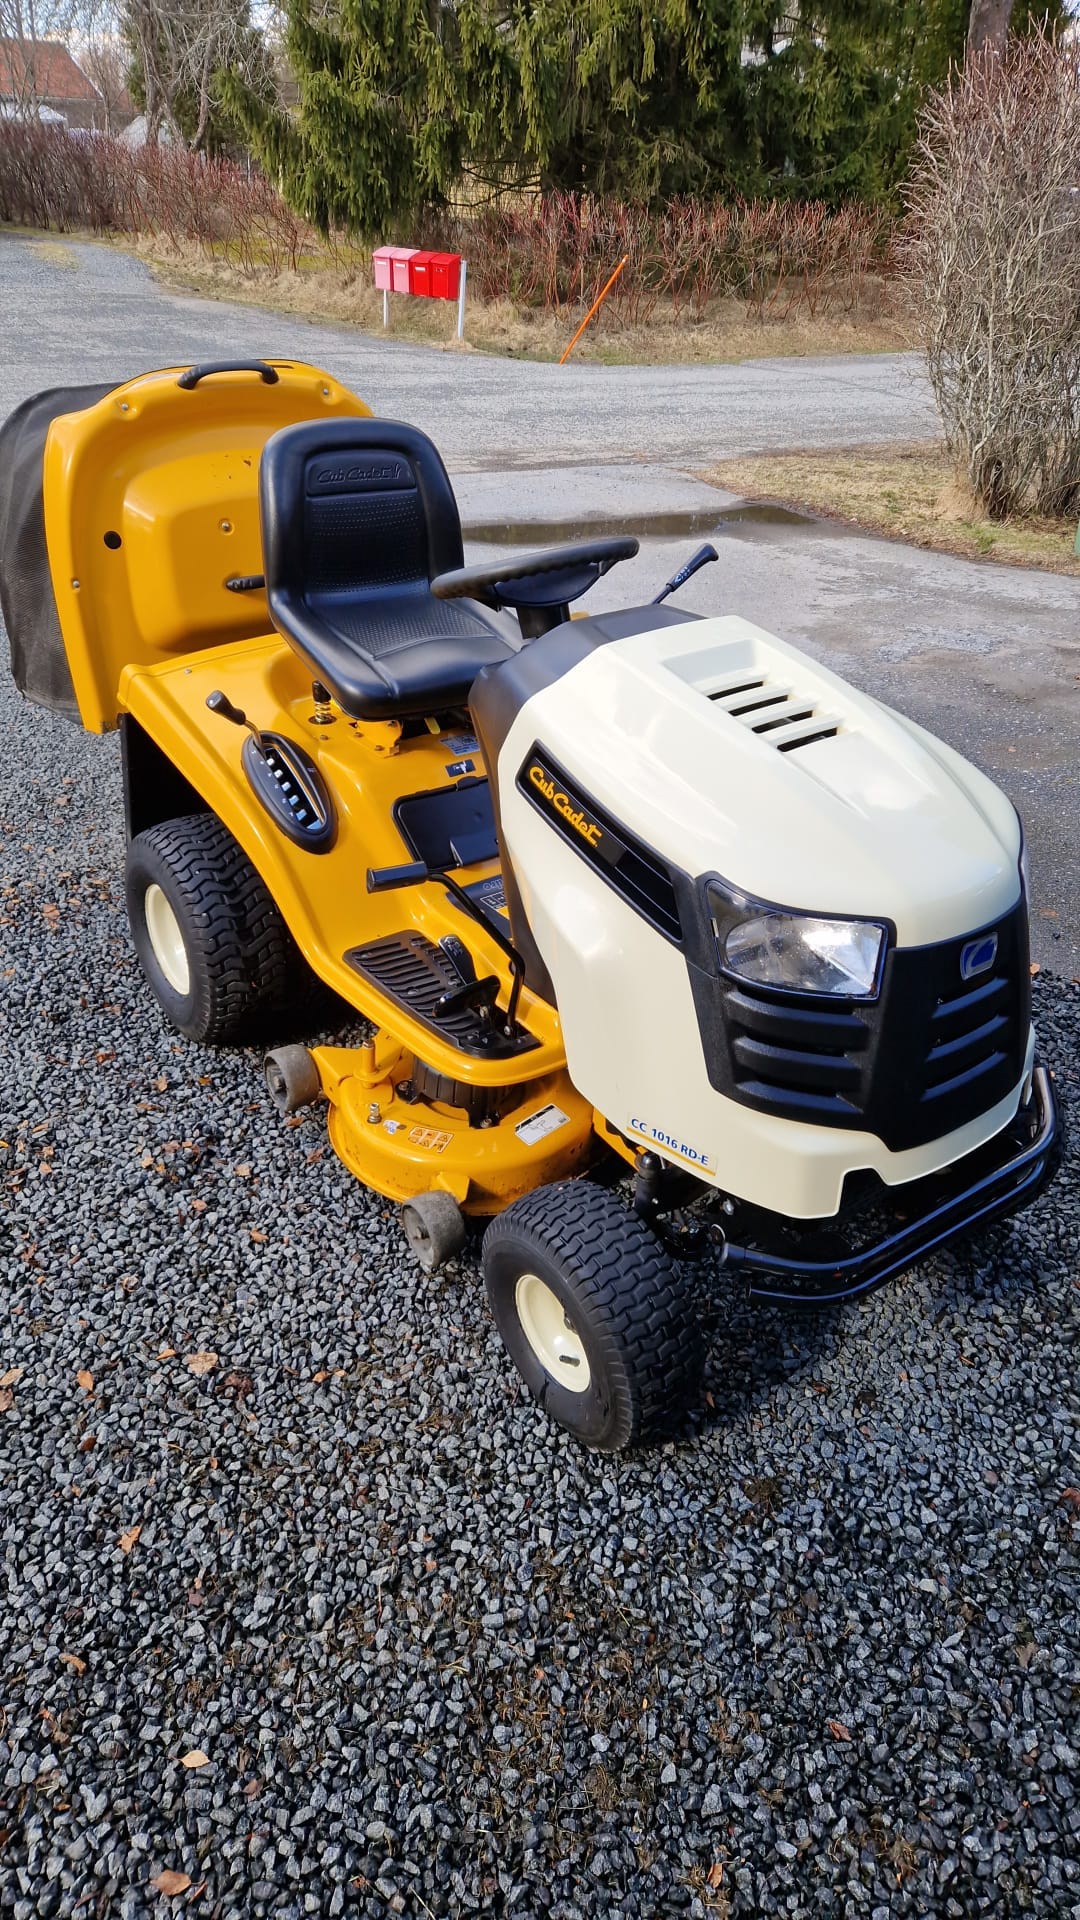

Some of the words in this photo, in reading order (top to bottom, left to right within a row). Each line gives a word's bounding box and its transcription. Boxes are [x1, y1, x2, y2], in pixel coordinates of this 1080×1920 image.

[318, 469, 346, 484] Cub
[529, 766, 555, 799] Cub
[553, 792, 602, 846] Cadet
[631, 1118, 647, 1133] CC
[652, 1128, 678, 1149] 1016
[680, 1143, 709, 1166] RD-E
